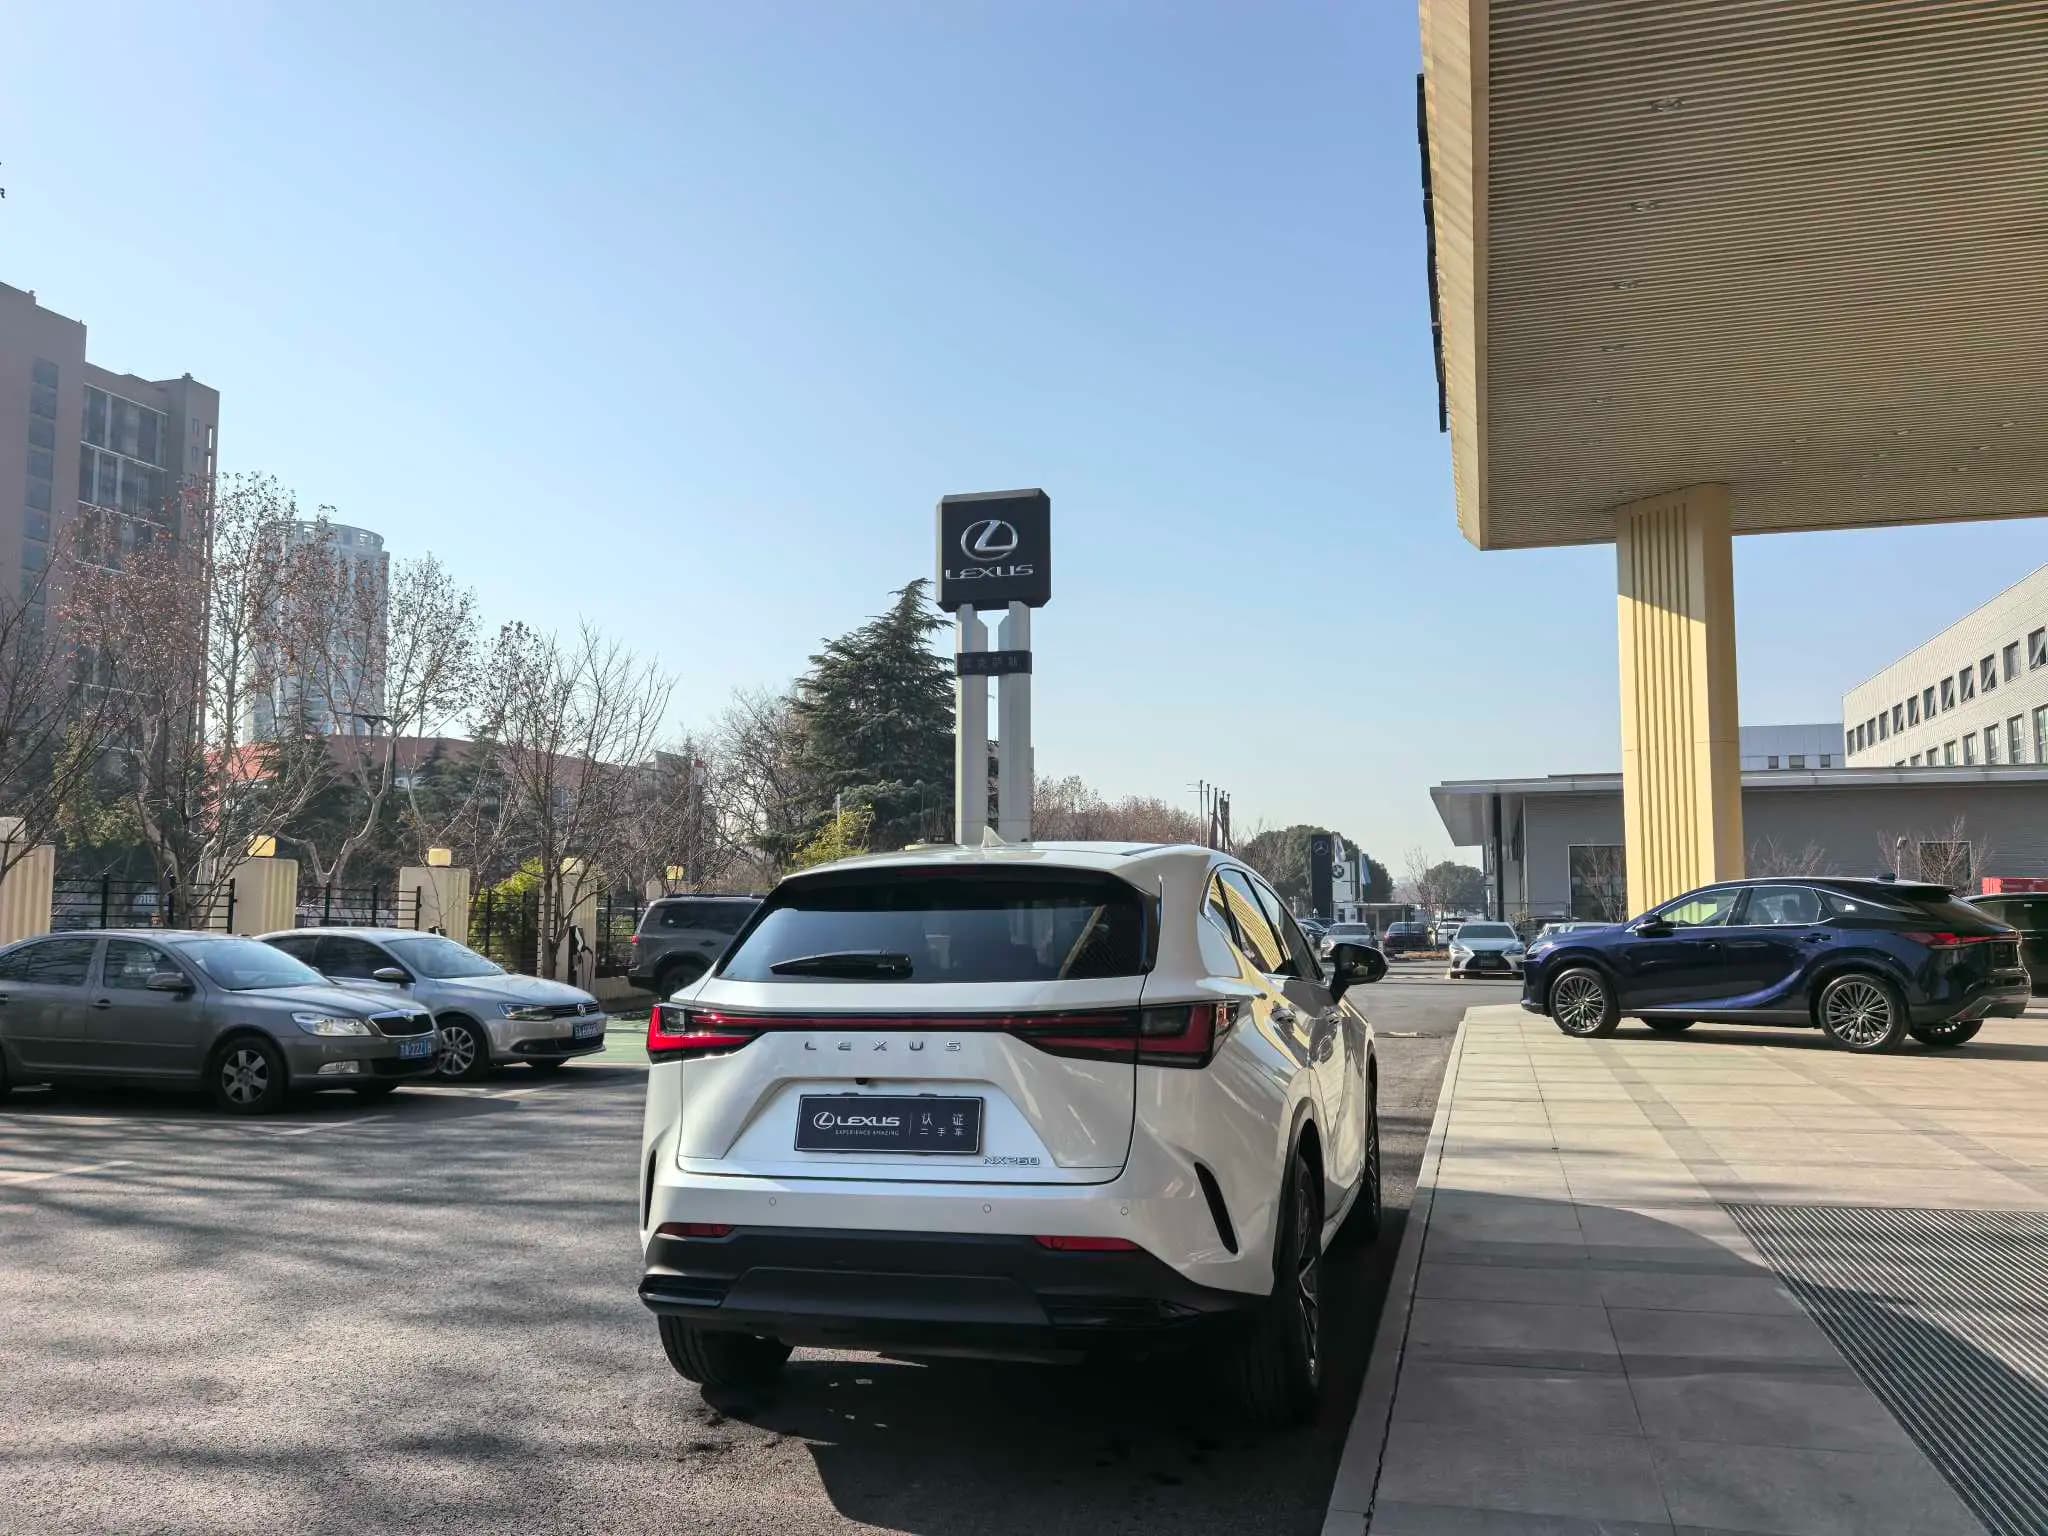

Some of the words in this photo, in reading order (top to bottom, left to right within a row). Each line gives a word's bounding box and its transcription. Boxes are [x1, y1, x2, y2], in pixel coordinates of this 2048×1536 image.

[945, 564, 1034, 579] LEXUS
[804, 1040, 962, 1052] LEXUS
[836, 1115, 901, 1127] LEXUS
[920, 1112, 967, 1127] 认证
